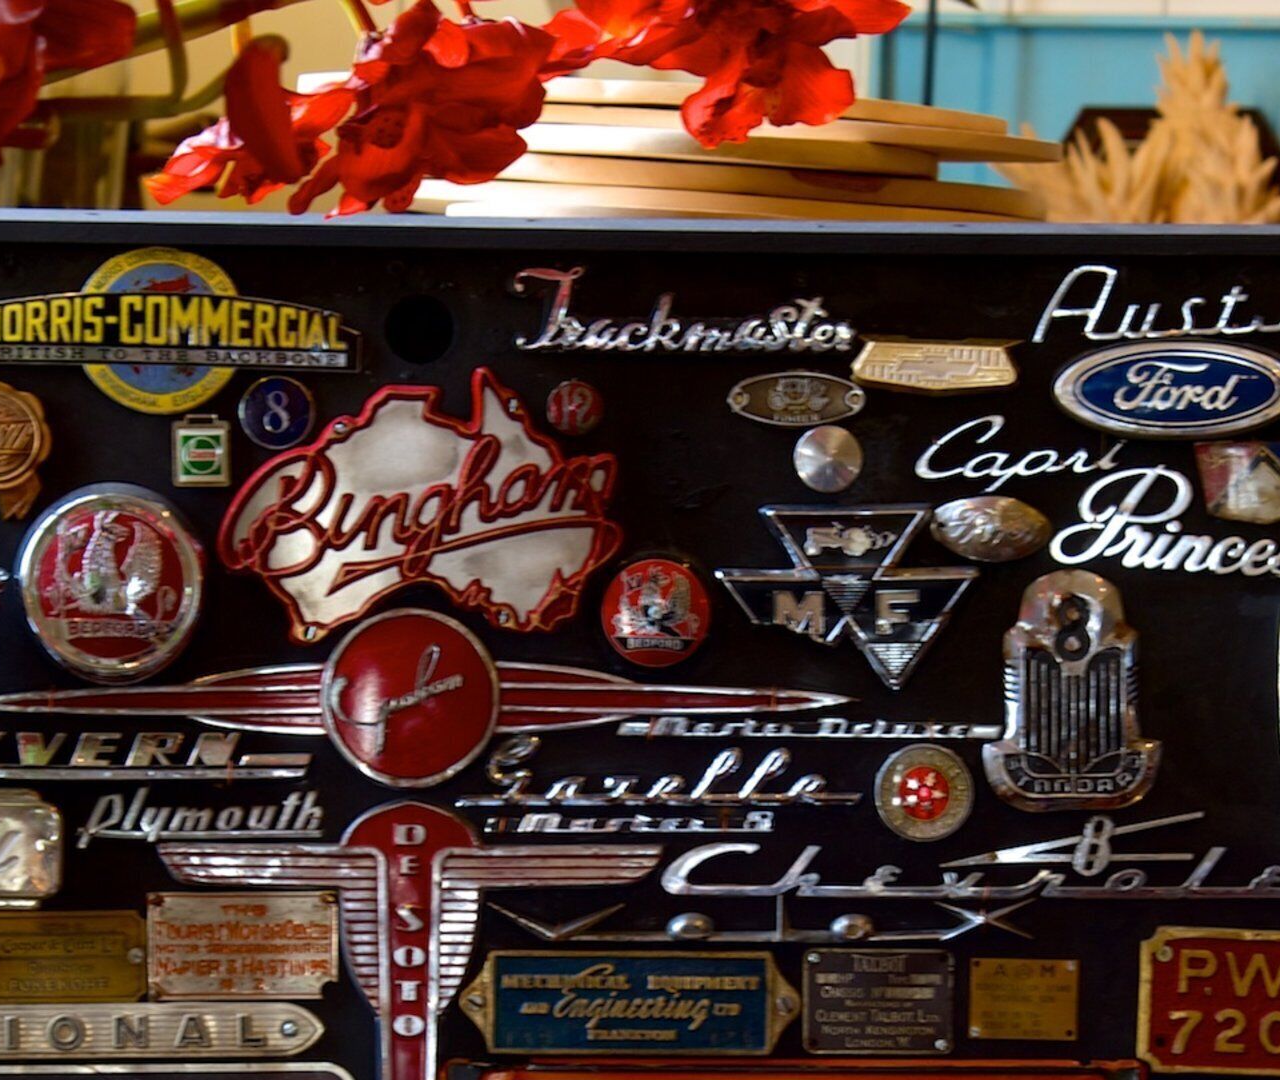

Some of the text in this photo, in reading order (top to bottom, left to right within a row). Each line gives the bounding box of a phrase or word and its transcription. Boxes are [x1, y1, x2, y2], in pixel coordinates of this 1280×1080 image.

[99, 348, 127, 361] TO
[142, 349, 190, 363] THE
[206, 350, 342, 368] BACKBONE
[1114, 360, 1240, 413] Ford
[263, 390, 291, 434] 8
[914, 415, 1127, 494] Capri
[220, 433, 617, 577] Bingham
[1055, 595, 1091, 662] 8
[485, 735, 830, 804] Gazelle
[77, 786, 324, 849] Plymouth
[552, 963, 713, 1031] Engineering
[646, 975, 760, 991] EQUIPMENT
